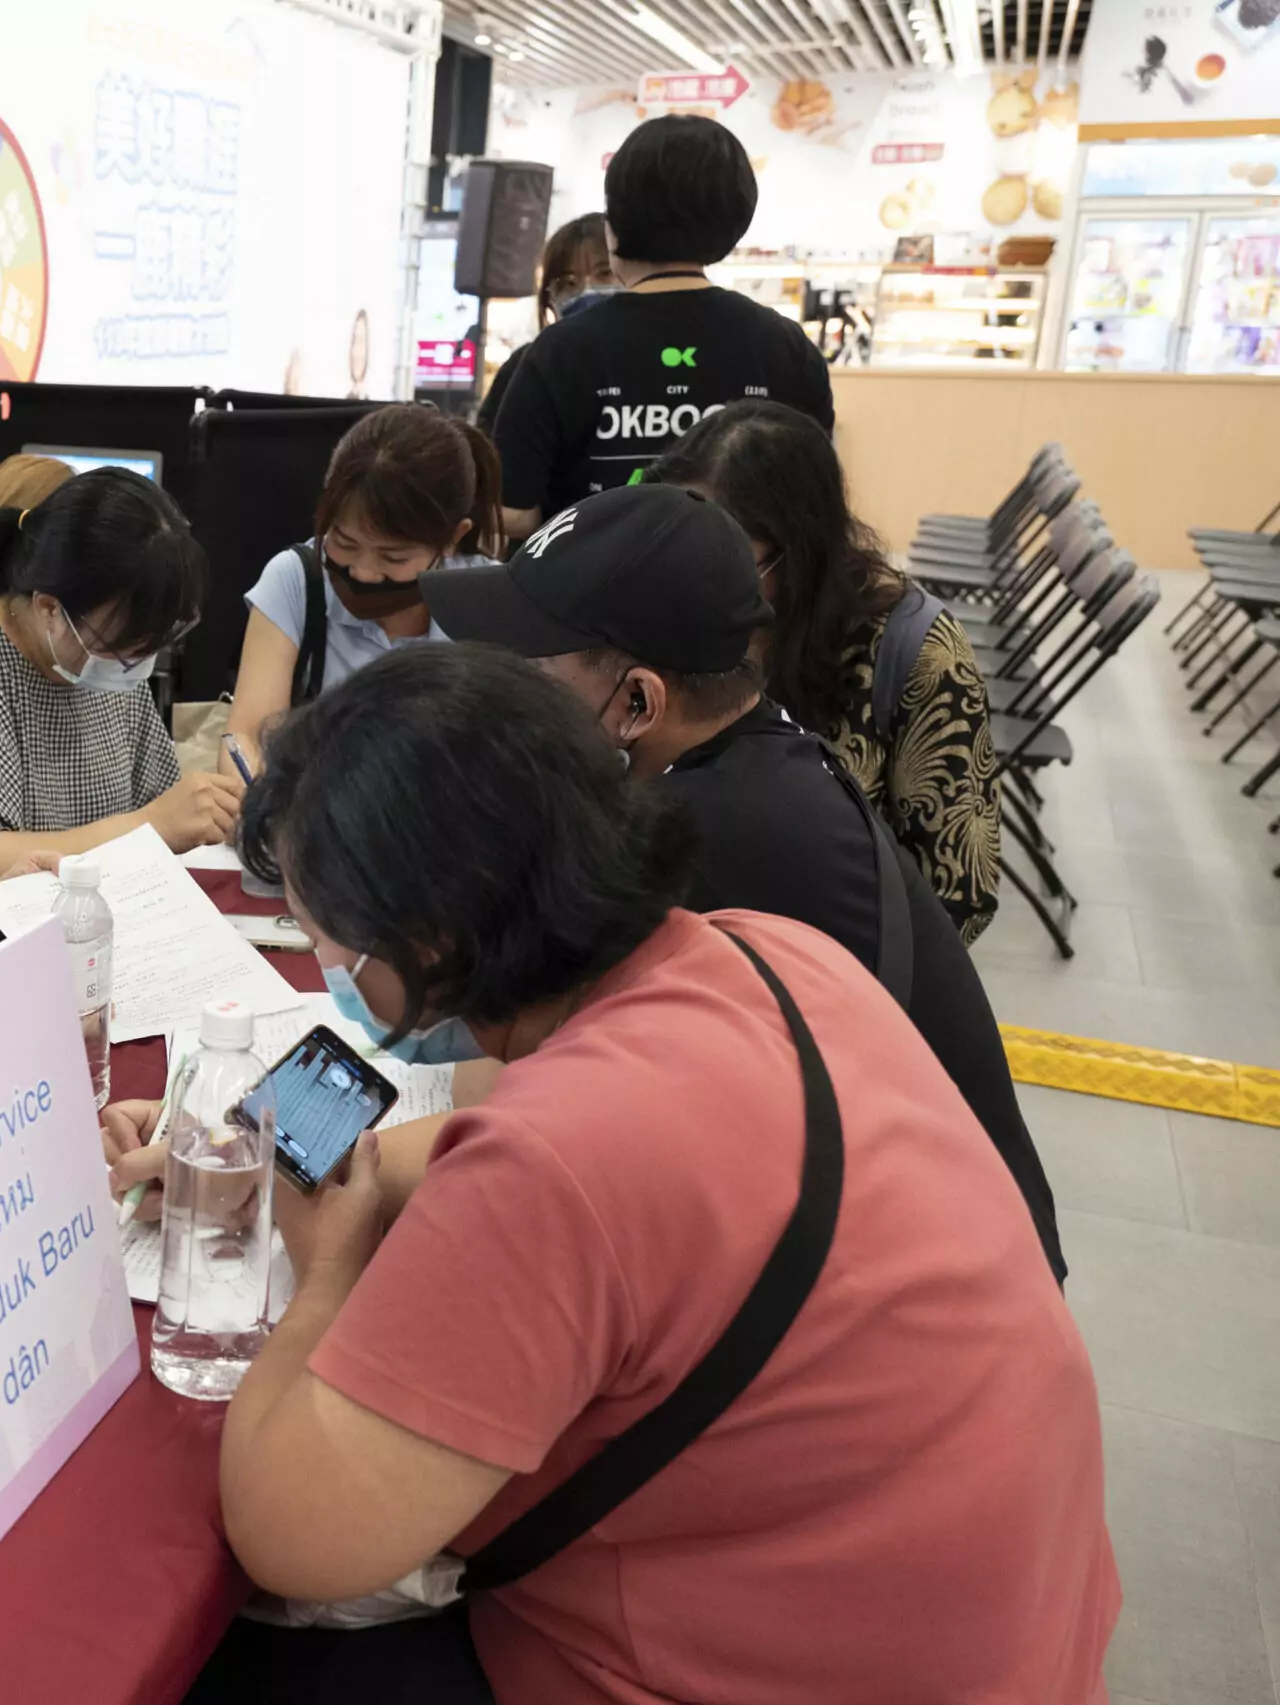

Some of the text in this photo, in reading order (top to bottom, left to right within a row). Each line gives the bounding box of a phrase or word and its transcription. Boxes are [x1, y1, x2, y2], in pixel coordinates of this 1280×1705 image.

[666, 384, 689, 395] CITY
[40, 1205, 95, 1293] Baru
[4, 1336, 50, 1404] dân
